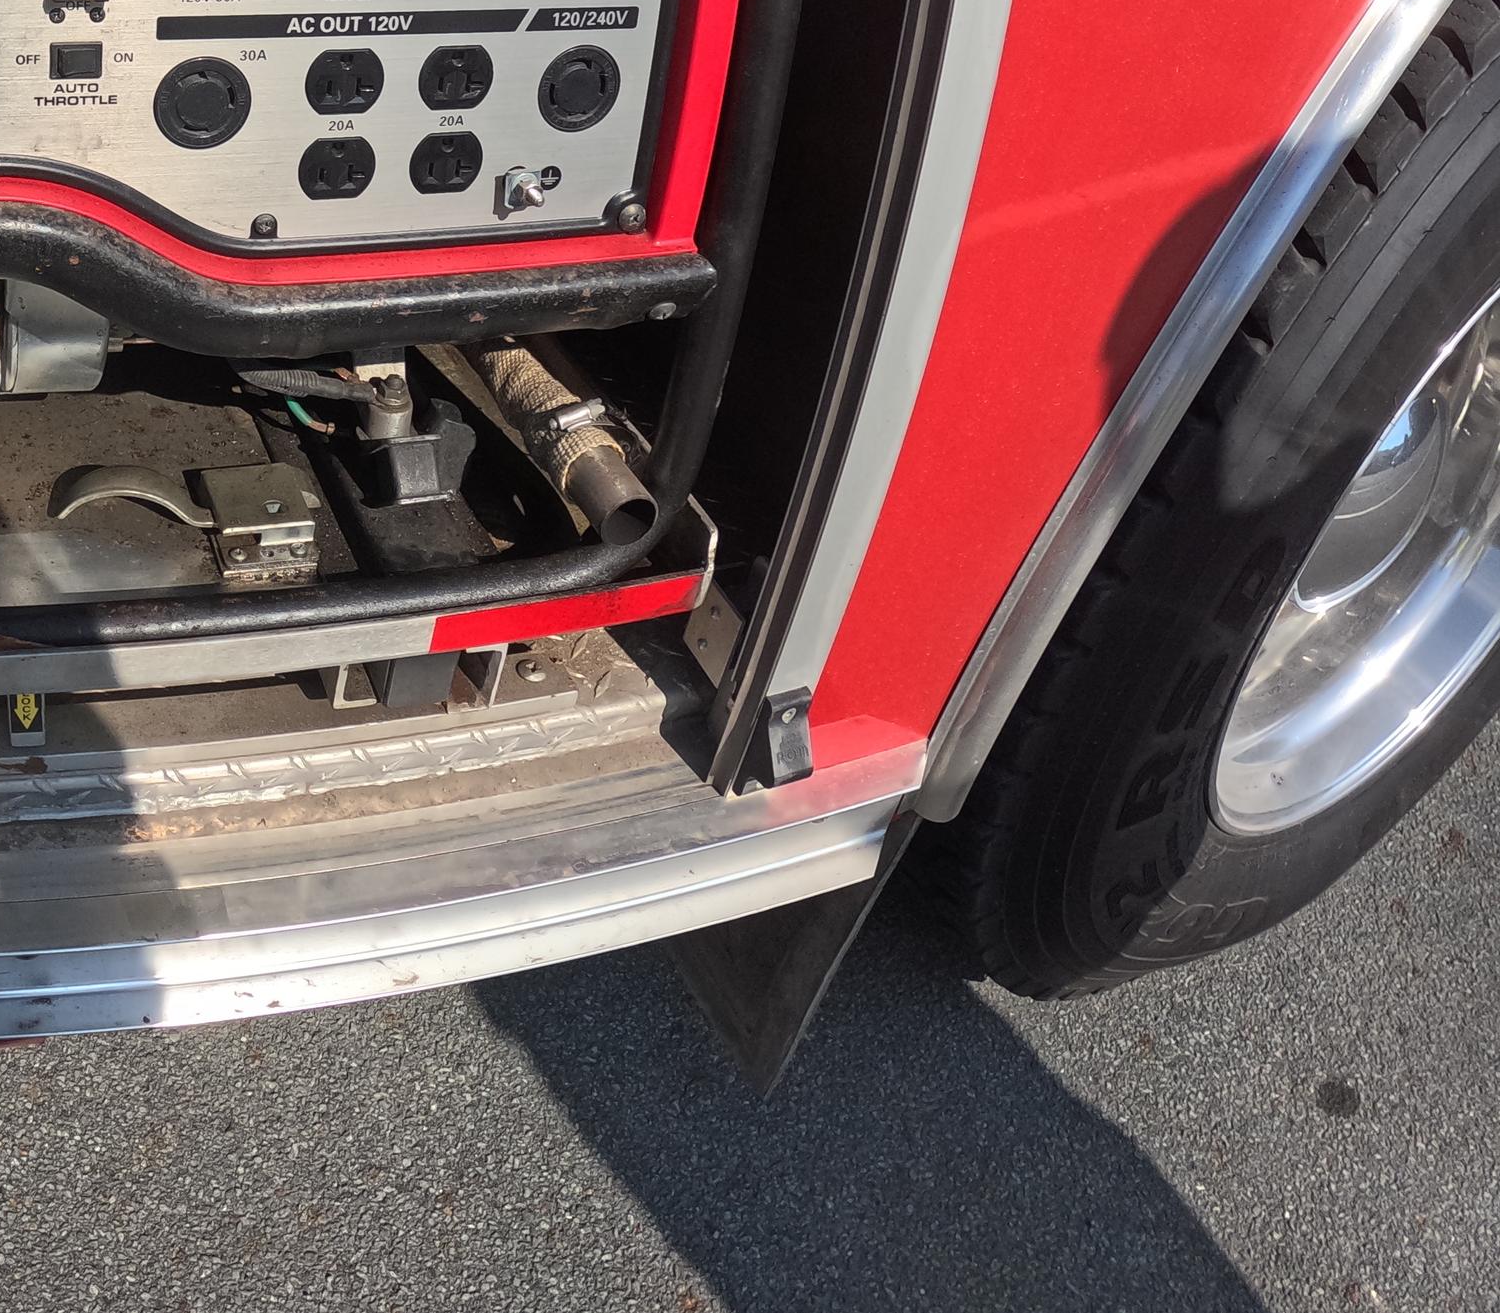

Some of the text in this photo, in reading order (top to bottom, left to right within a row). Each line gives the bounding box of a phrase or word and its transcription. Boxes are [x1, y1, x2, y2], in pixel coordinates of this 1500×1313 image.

[65, 0, 91, 11] OFF
[552, 10, 629, 27] 120/240V
[286, 15, 413, 34] AC OUT 120V
[15, 55, 41, 65] OFF
[113, 52, 134, 63] ON
[239, 50, 267, 61] 30A
[53, 83, 99, 93] AUTO
[34, 95, 118, 107] THROTTLE
[328, 120, 354, 131] 20A
[439, 115, 464, 127] 20A
